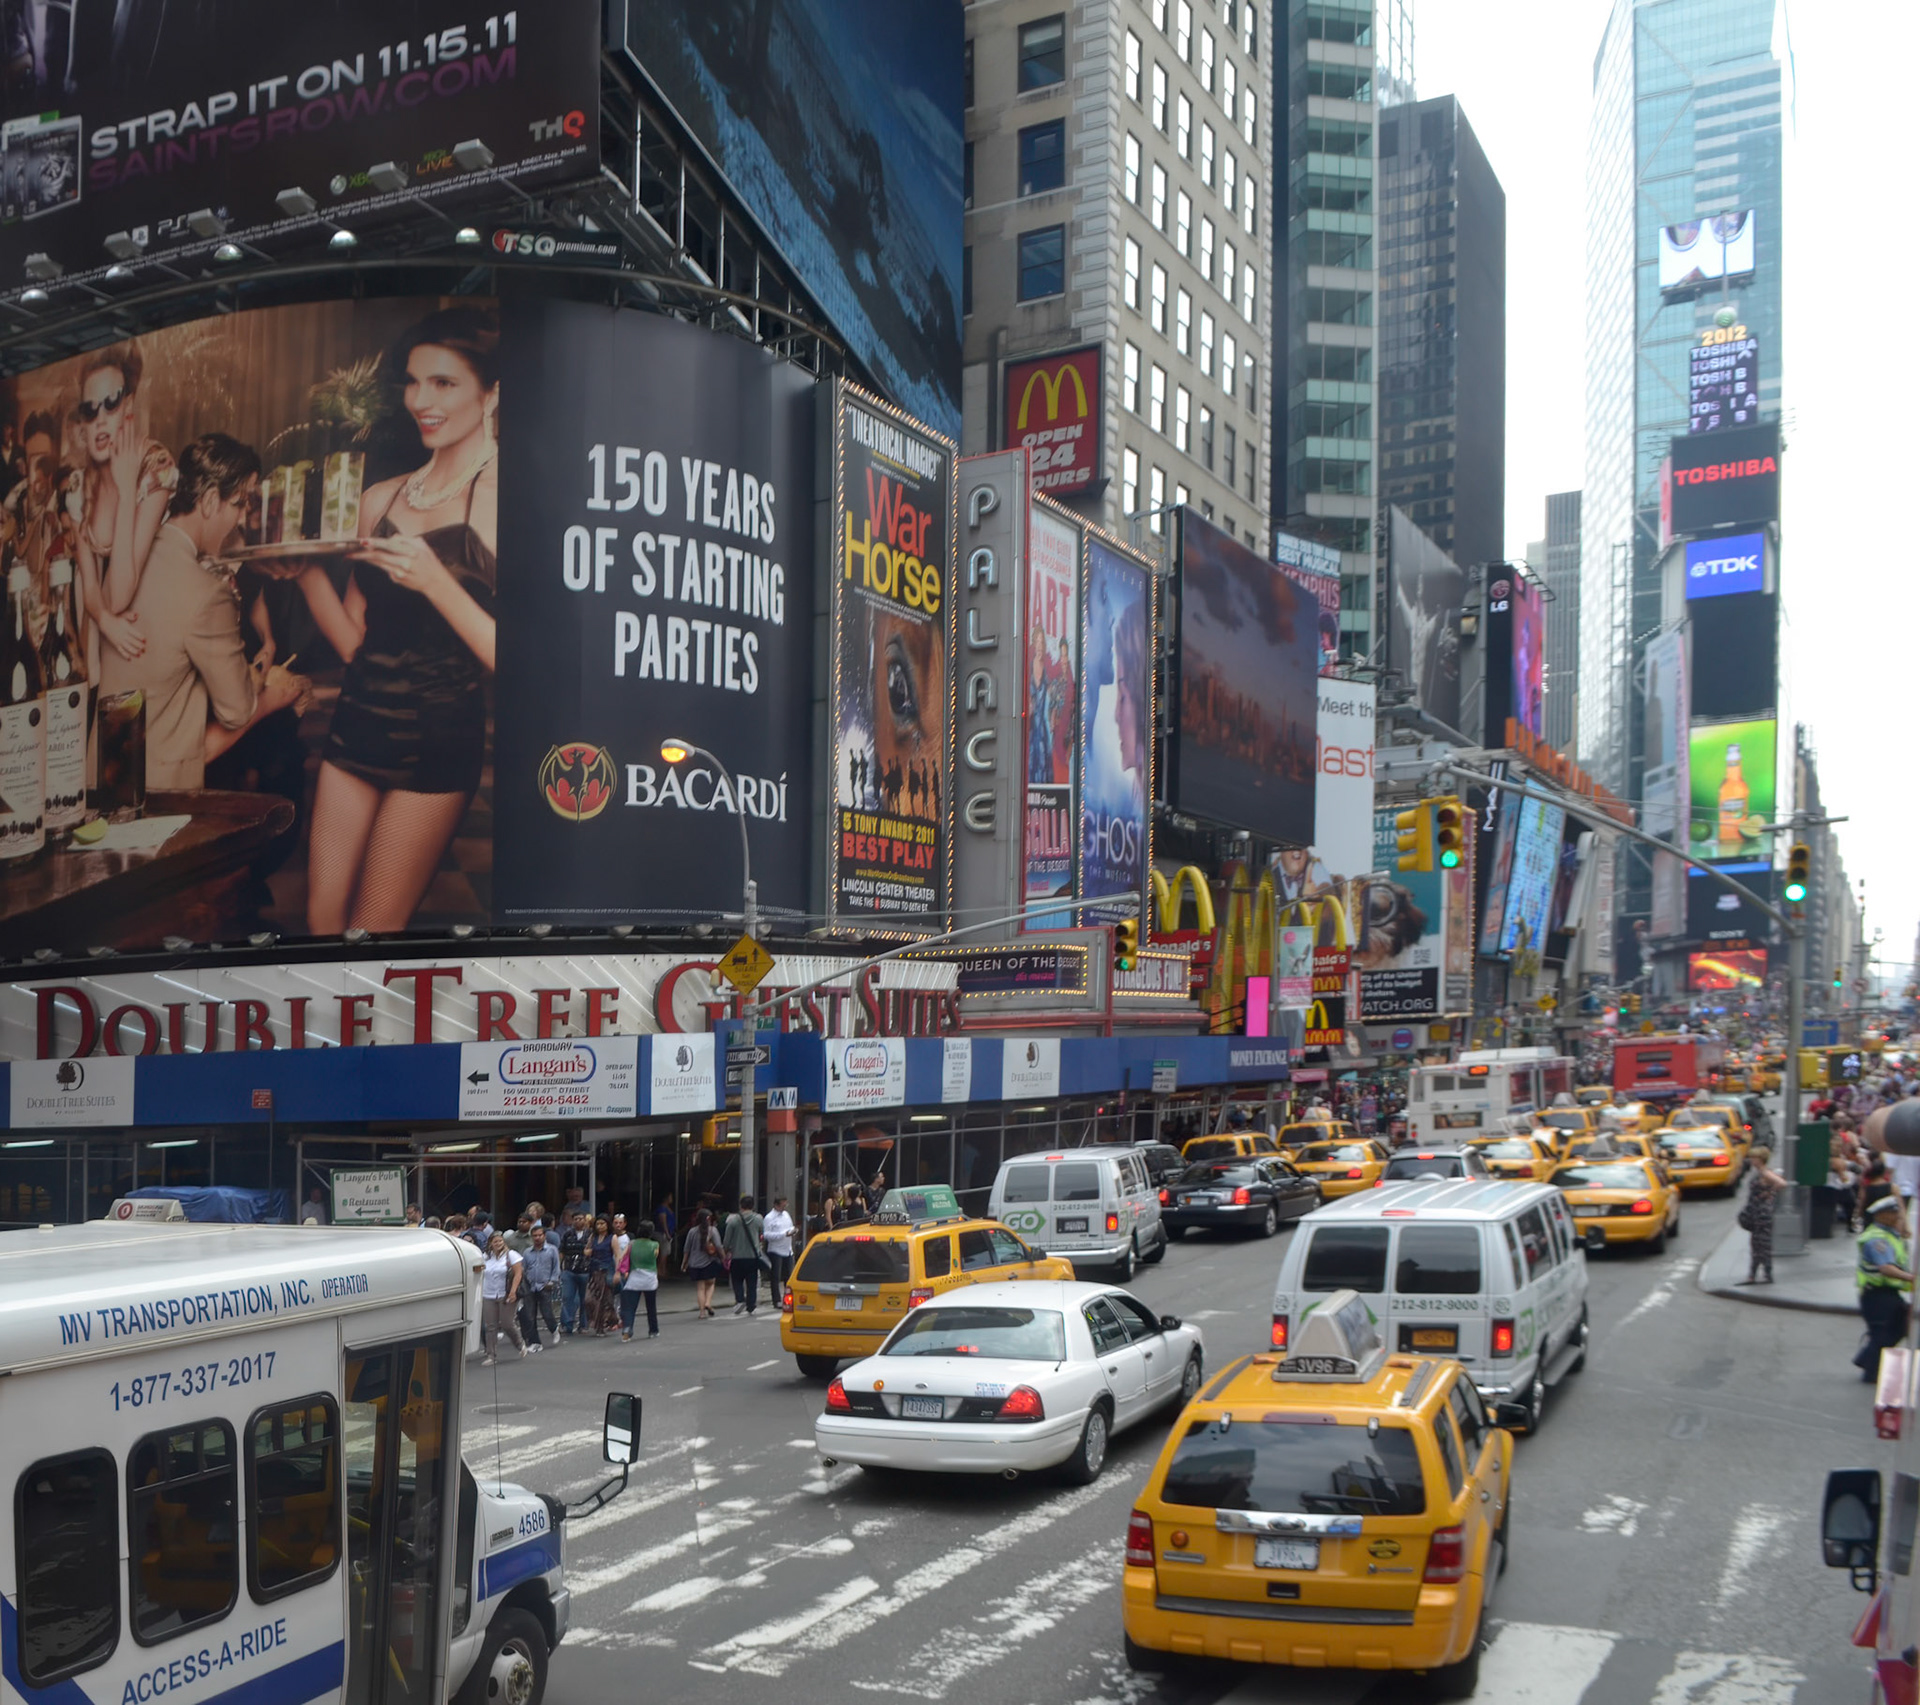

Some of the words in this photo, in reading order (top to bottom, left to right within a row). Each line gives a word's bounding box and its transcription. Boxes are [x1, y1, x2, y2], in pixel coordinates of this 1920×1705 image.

[90, 92, 237, 158] STRAP
[248, 75, 288, 113] IT
[296, 54, 364, 99] ON
[378, 11, 518, 77] 11.15.11
[90, 50, 517, 192] SAINTSROW.COM
[529, 110, 585, 142] THQ
[1691, 339, 1757, 360] TOSHIBA
[1702, 325, 1748, 347] 2012
[1021, 424, 1084, 447] OPEN
[1033, 442, 1077, 472] 24
[1673, 456, 1776, 487] TOSHIBA
[586, 443, 668, 516] 150
[681, 456, 775, 544] YEARS
[1033, 467, 1091, 490] OURS
[866, 466, 932, 558] War
[563, 525, 618, 592] OF
[632, 531, 785, 626] STARTING
[845, 511, 941, 614] Horse
[1705, 554, 1759, 577] TDK
[1490, 600, 1509, 614] LG
[614, 610, 759, 695] PARTIES
[964, 483, 1000, 832] PALACE
[1317, 696, 1355, 717] Meet
[624, 763, 787, 822] BACARDÍ
[842, 812, 852, 831] 5
[854, 813, 878, 834] TONY
[879, 818, 914, 842] AWARDS
[915, 826, 935, 845] 2011
[1082, 810, 1148, 867] GHOST
[842, 832, 889, 863] BEST
[892, 840, 935, 870] PLAY
[842, 878, 874, 897] LINCOLN
[875, 881, 903, 897] CENTER
[904, 885, 935, 902] THEATER
[957, 957, 1002, 975] QUEEN
[1007, 957, 1027, 971] OF
[1038, 956, 1056, 968] THE
[523, 1042, 573, 1053] BROADWAY
[508, 1054, 588, 1077] Langan's
[1004, 1212, 1040, 1231] GO
[58, 1311, 91, 1345] MV
[97, 1285, 278, 1339] TRANSPORTATION,
[281, 1279, 314, 1309] INC.
[321, 1273, 369, 1299] OPERATOR
[110, 1351, 276, 1411] 1-877-337-2017
[518, 1509, 546, 1537] 4586
[121, 1618, 287, 1705] ACCESS-A-RIDE
